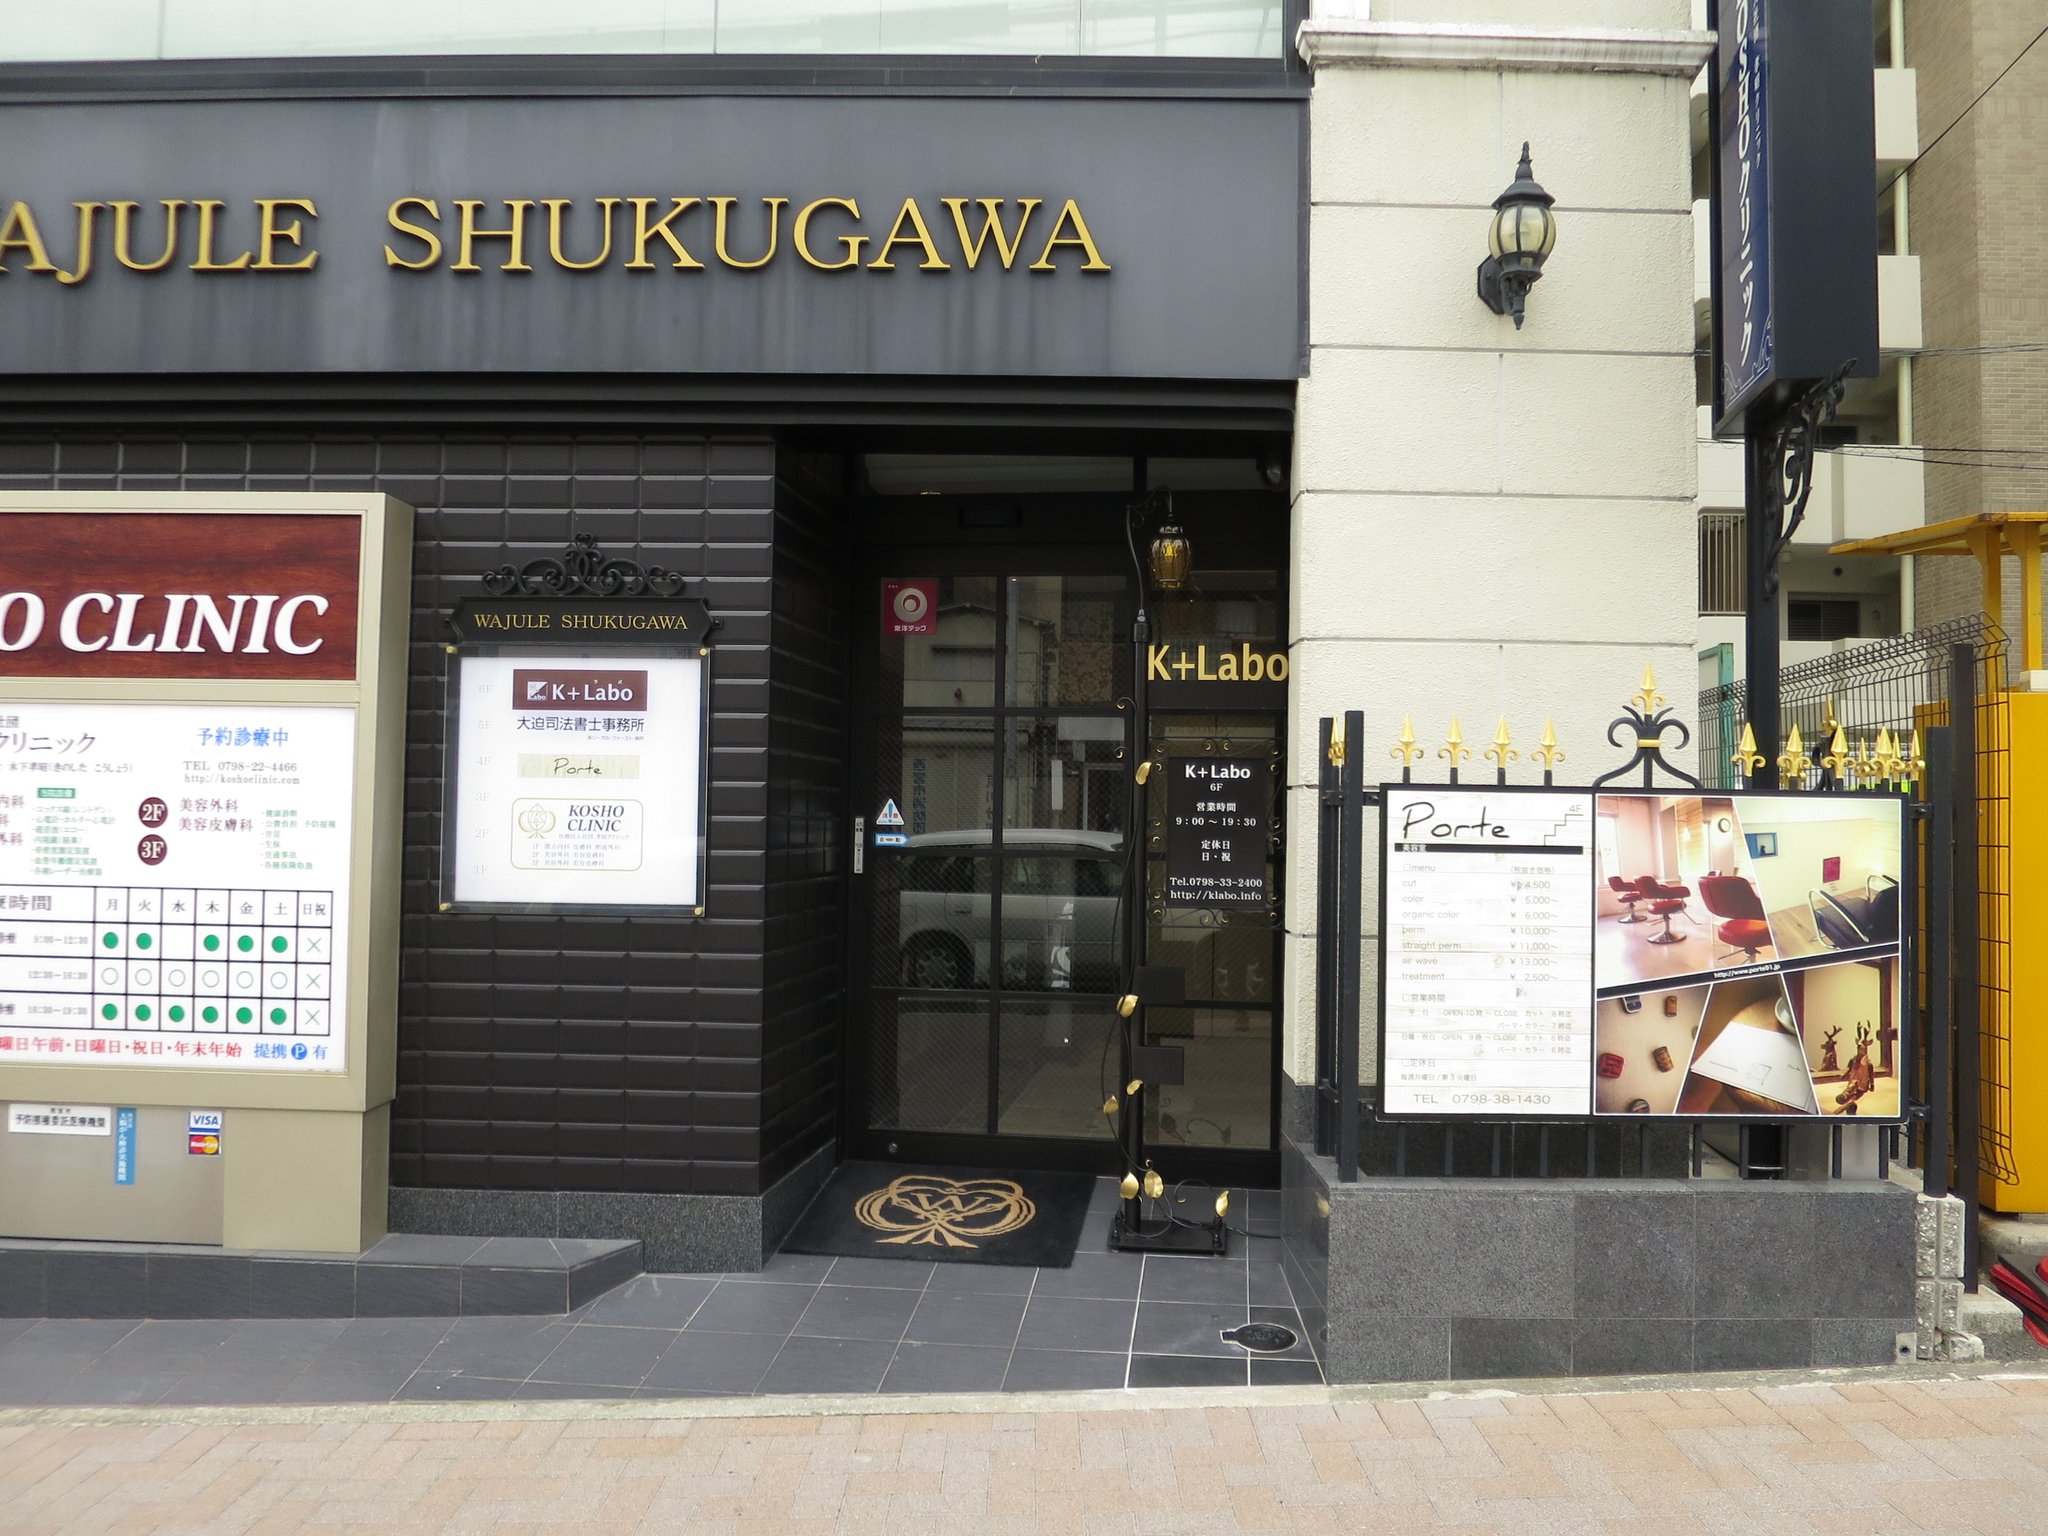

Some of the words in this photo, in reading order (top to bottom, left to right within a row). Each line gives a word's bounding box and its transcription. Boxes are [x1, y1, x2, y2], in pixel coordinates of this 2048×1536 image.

[384, 197, 1112, 272] SHUKUGAWA
[1739, 160, 1754, 367] クリニック
[60, 593, 329, 655] CLINIC
[475, 614, 550, 630] WAJULE
[561, 615, 688, 630] SHUKUGAWA
[517, 716, 645, 732] 大迫司法書士事務所
[197, 726, 289, 747] 予約診療中
[183, 761, 211, 772] TEL
[218, 762, 298, 774] 0798-22-4466
[553, 757, 602, 775] Porte
[1210, 783, 1223, 792] 6F
[180, 798, 239, 813] 美容外科
[568, 805, 625, 818] KOSHO
[1196, 802, 1237, 813] 営業時間
[142, 804, 165, 822] 2F
[178, 817, 254, 832] 美容皮膚科
[567, 819, 622, 832] CLINIC
[1402, 802, 1510, 839] Porte
[1569, 804, 1582, 813] 4F
[141, 841, 164, 859] 3F
[1201, 840, 1231, 850] 定休日
[1202, 852, 1231, 862] 日・祝
[1170, 877, 1263, 888] Tel.0798-33-2400
[1402, 879, 1417, 887] cut
[1170, 890, 1262, 901] http://klabo.info
[1402, 895, 1424, 903] color
[107, 899, 118, 911] 月
[138, 900, 152, 912] 火
[171, 900, 186, 913] 水
[205, 901, 220, 914] 木
[240, 902, 254, 915] 金
[273, 902, 288, 915] 土
[1402, 910, 1434, 920] organic
[1437, 910, 1460, 919] color
[1402, 926, 1425, 935] perm
[1402, 941, 1436, 952] straight
[1438, 942, 1462, 951] perm
[1402, 972, 1445, 980] treatment
[1411, 993, 1446, 1003] 営業時間
[1411, 1058, 1436, 1067] 定休日
[1413, 1094, 1438, 1103] TEL
[1453, 1094, 1550, 1104] 0798-38-1430
[193, 1116, 219, 1126] VISA
